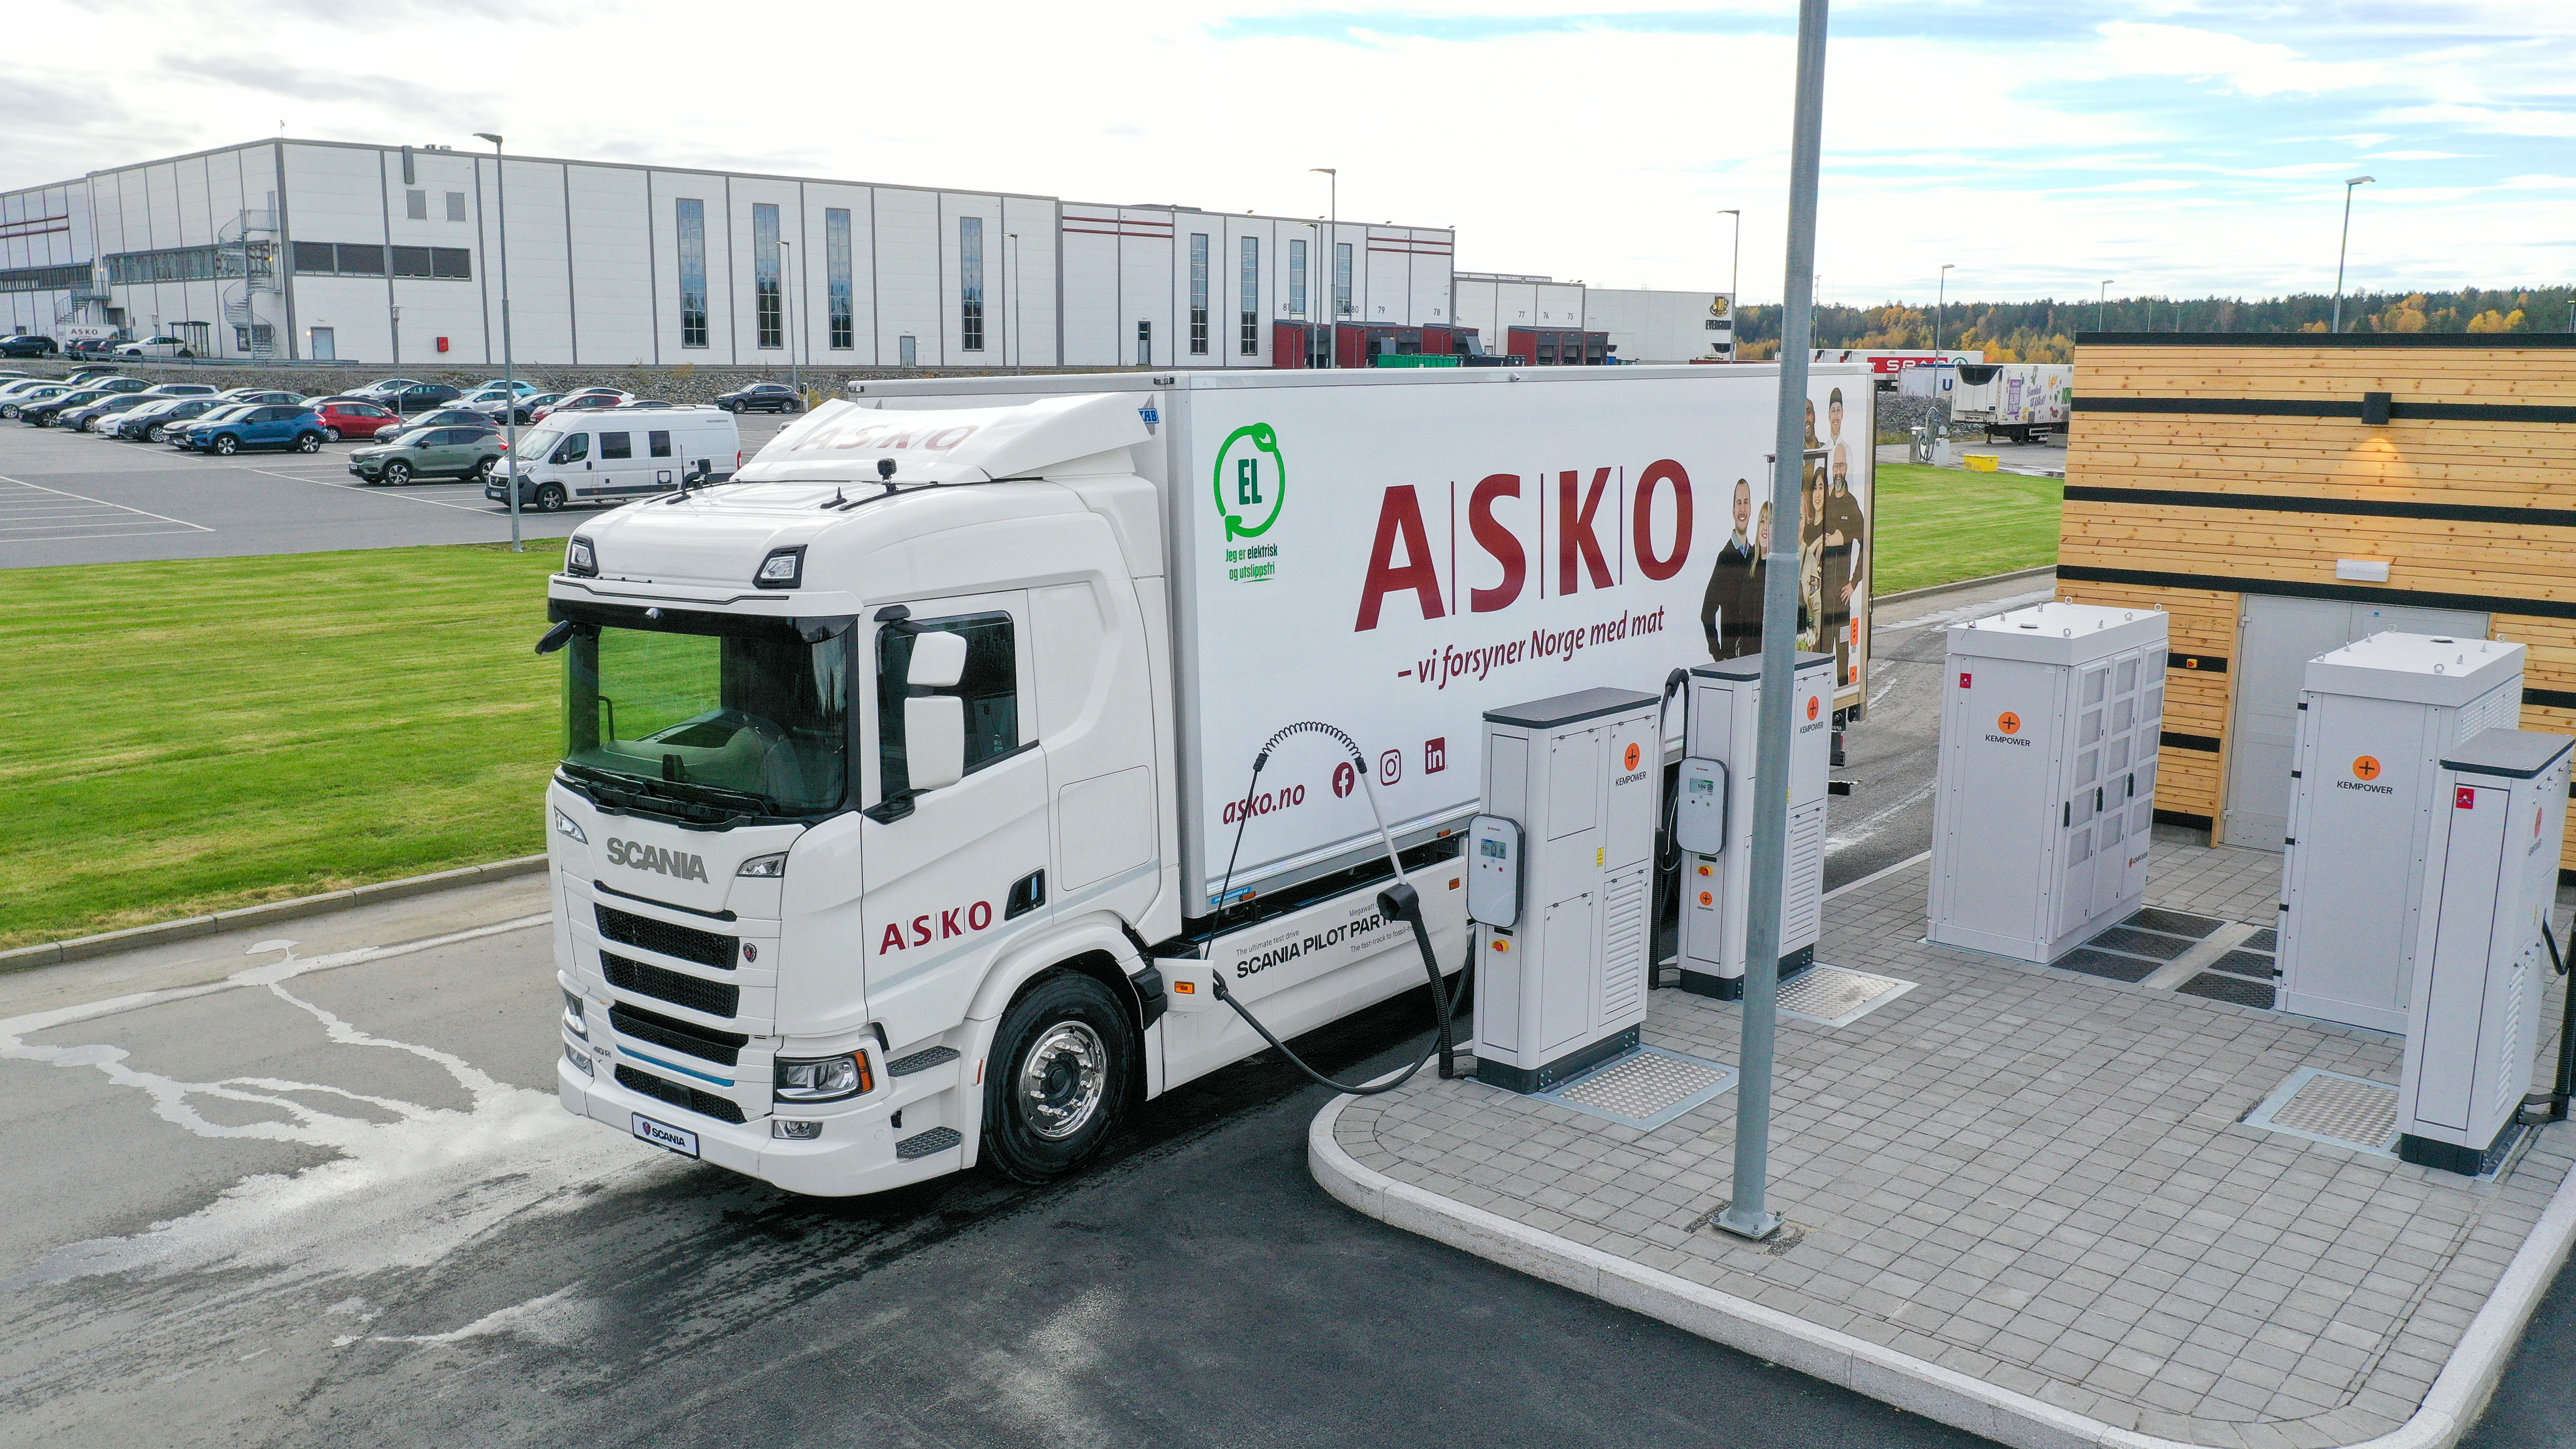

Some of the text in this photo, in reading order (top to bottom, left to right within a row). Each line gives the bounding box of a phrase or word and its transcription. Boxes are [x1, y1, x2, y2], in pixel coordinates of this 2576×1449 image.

[791, 425, 979, 451] ASKO
[1238, 458, 1262, 505] EL
[1225, 543, 1278, 563] Jeg er elektrisk
[1354, 459, 1693, 633] ASKO
[1229, 561, 1275, 582] og utslippsfri
[1418, 649, 1436, 684] vi
[1438, 639, 1526, 690] forsyner
[1530, 628, 1585, 662] Norge
[1590, 610, 1627, 646] med
[1632, 605, 1665, 637] mat
[1800, 721, 1824, 734] KEMPOWER
[1985, 734, 2030, 747] KEMPOWER
[1615, 771, 1646, 787] KEMPOWER
[2337, 780, 2393, 795] KEMPOWER
[1223, 784, 1305, 825] asko.no
[607, 837, 710, 884] SCANIA
[1349, 902, 1374, 918] Megawatt
[879, 900, 992, 956] ASKO
[1236, 929, 1299, 957] The ultimate test drive
[1237, 942, 1301, 979] SCANIA
[1304, 924, 1347, 955] PILOT
[1350, 945, 1360, 953] The
[1361, 934, 1386, 949] fast-track
[652, 1127, 686, 1147] SCANIA
